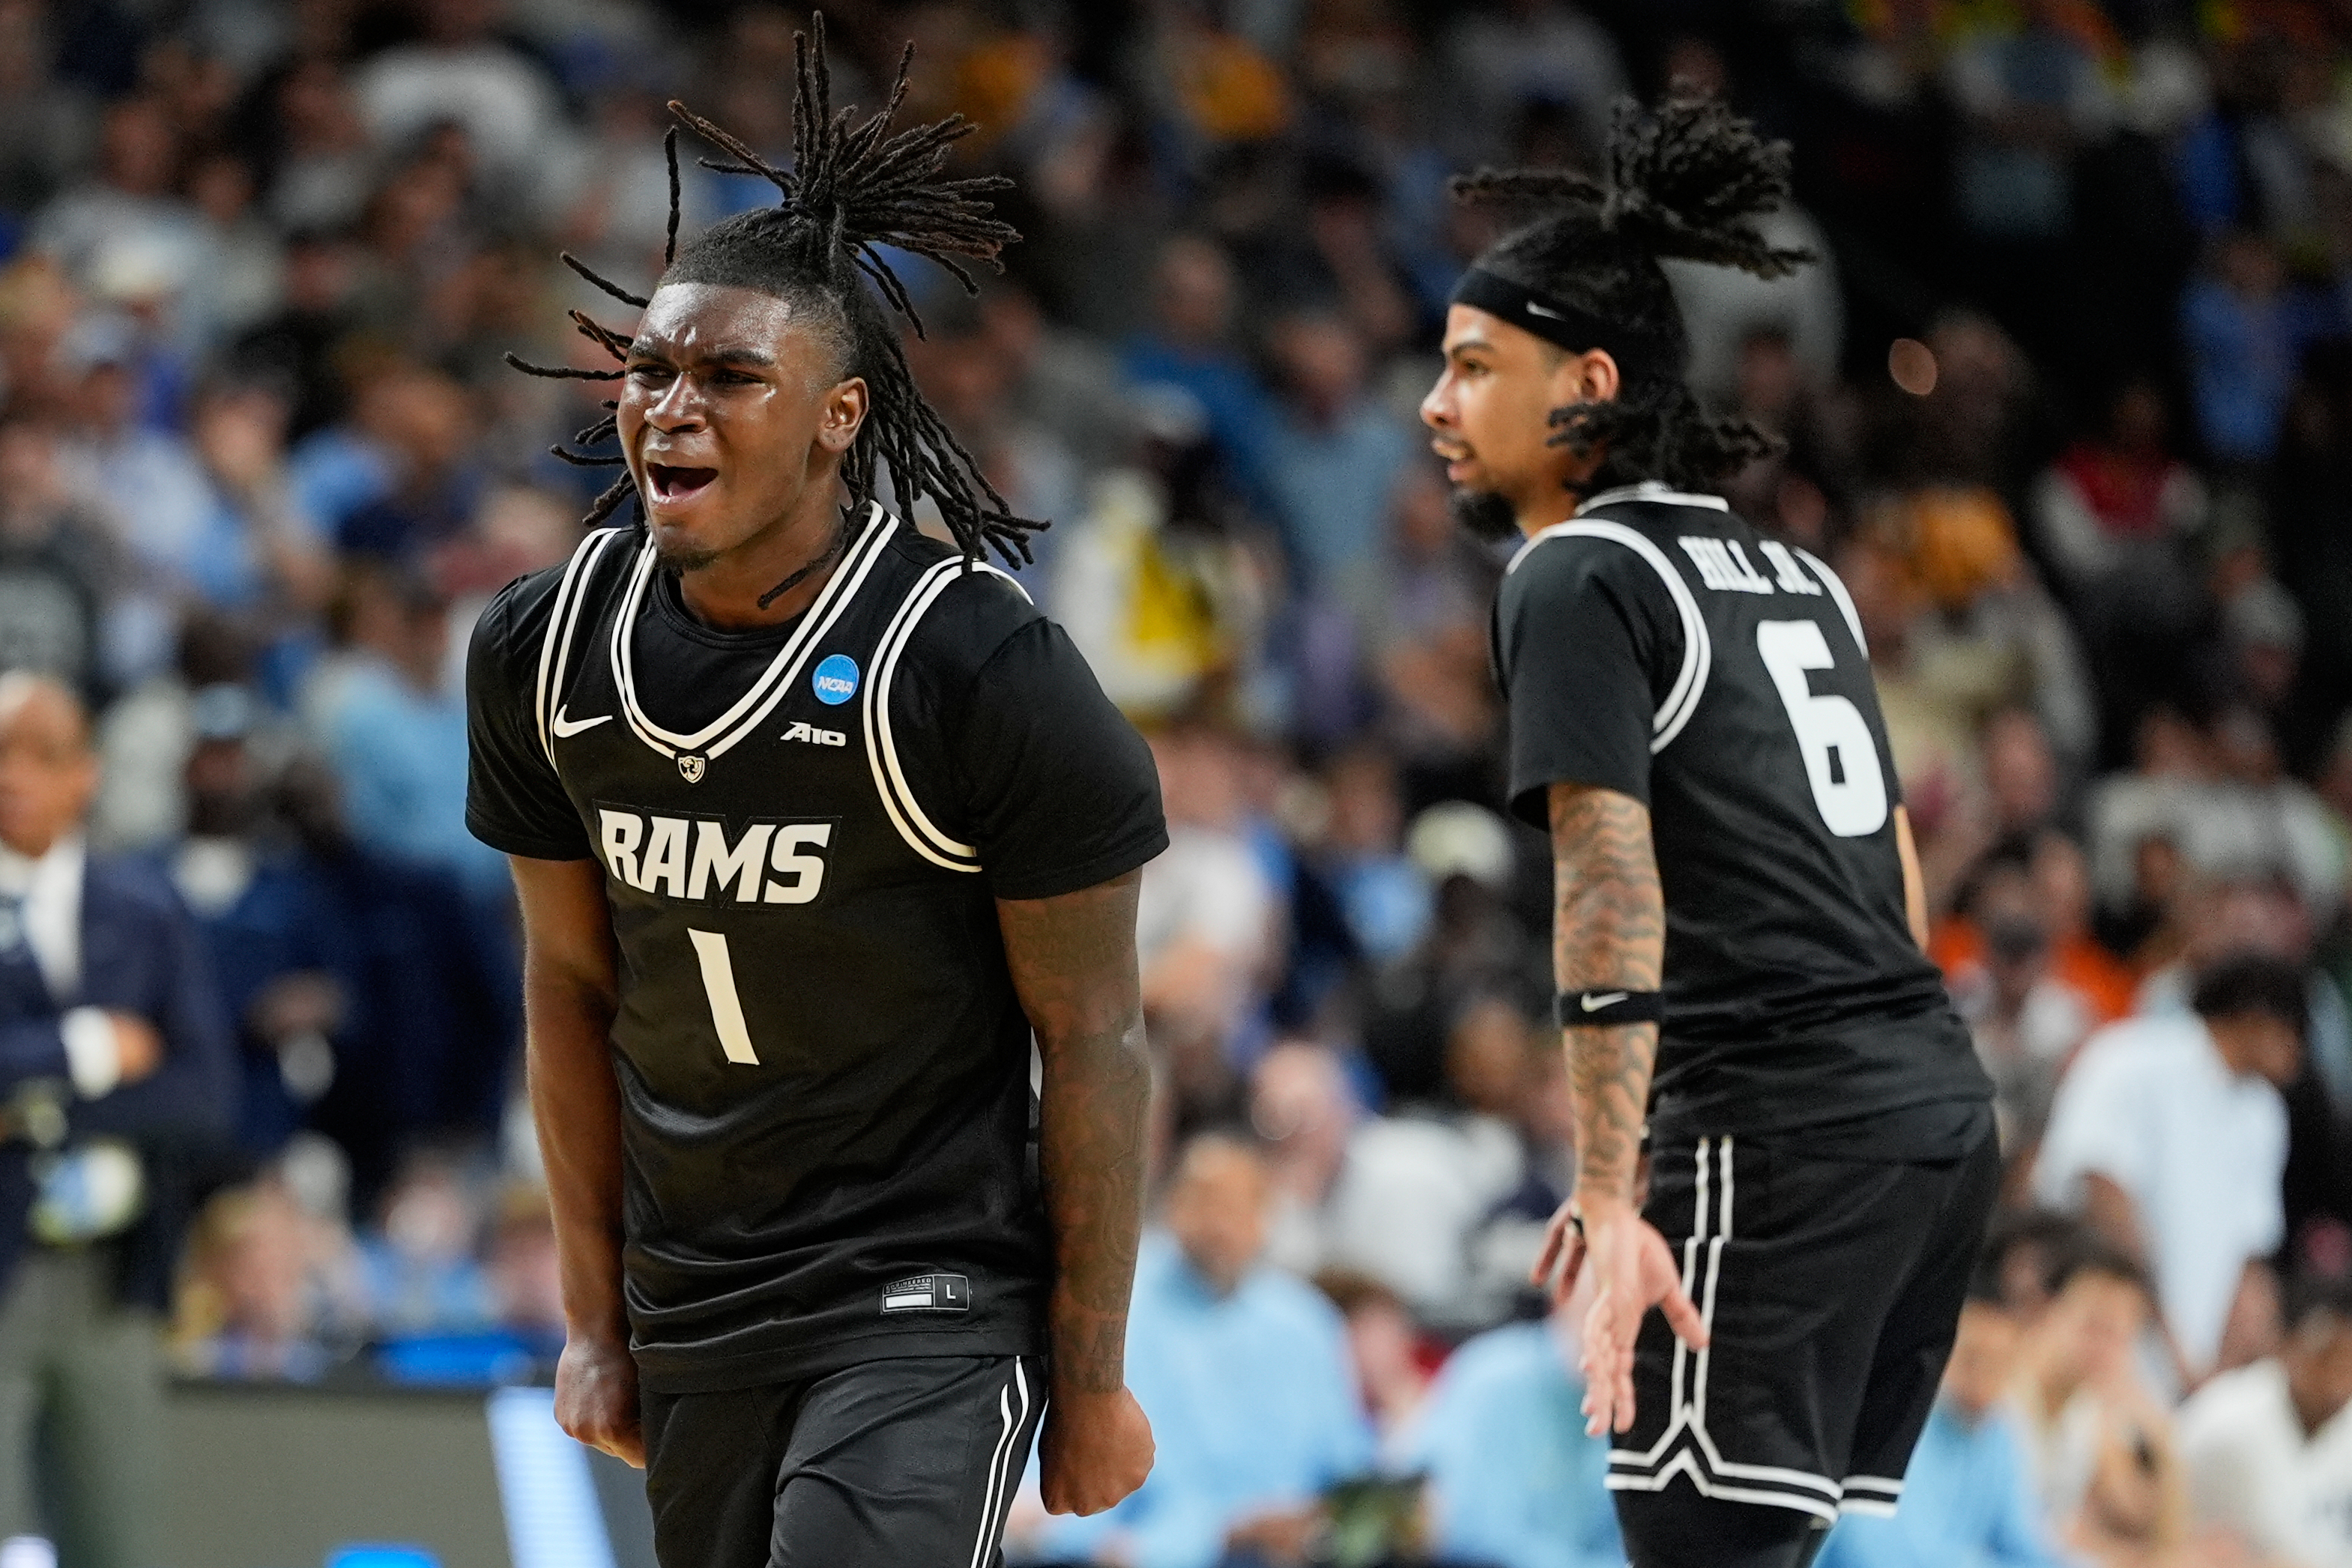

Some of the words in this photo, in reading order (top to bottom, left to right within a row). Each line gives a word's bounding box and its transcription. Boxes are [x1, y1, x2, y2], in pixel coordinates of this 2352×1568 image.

[1678, 536, 1775, 595] HILL
[817, 676, 854, 694] NCAA
[781, 721, 847, 746] A10
[1757, 620, 1887, 838] 6
[599, 808, 831, 904] RAMS
[687, 927, 759, 1065] 1
[946, 1284, 956, 1299] L
